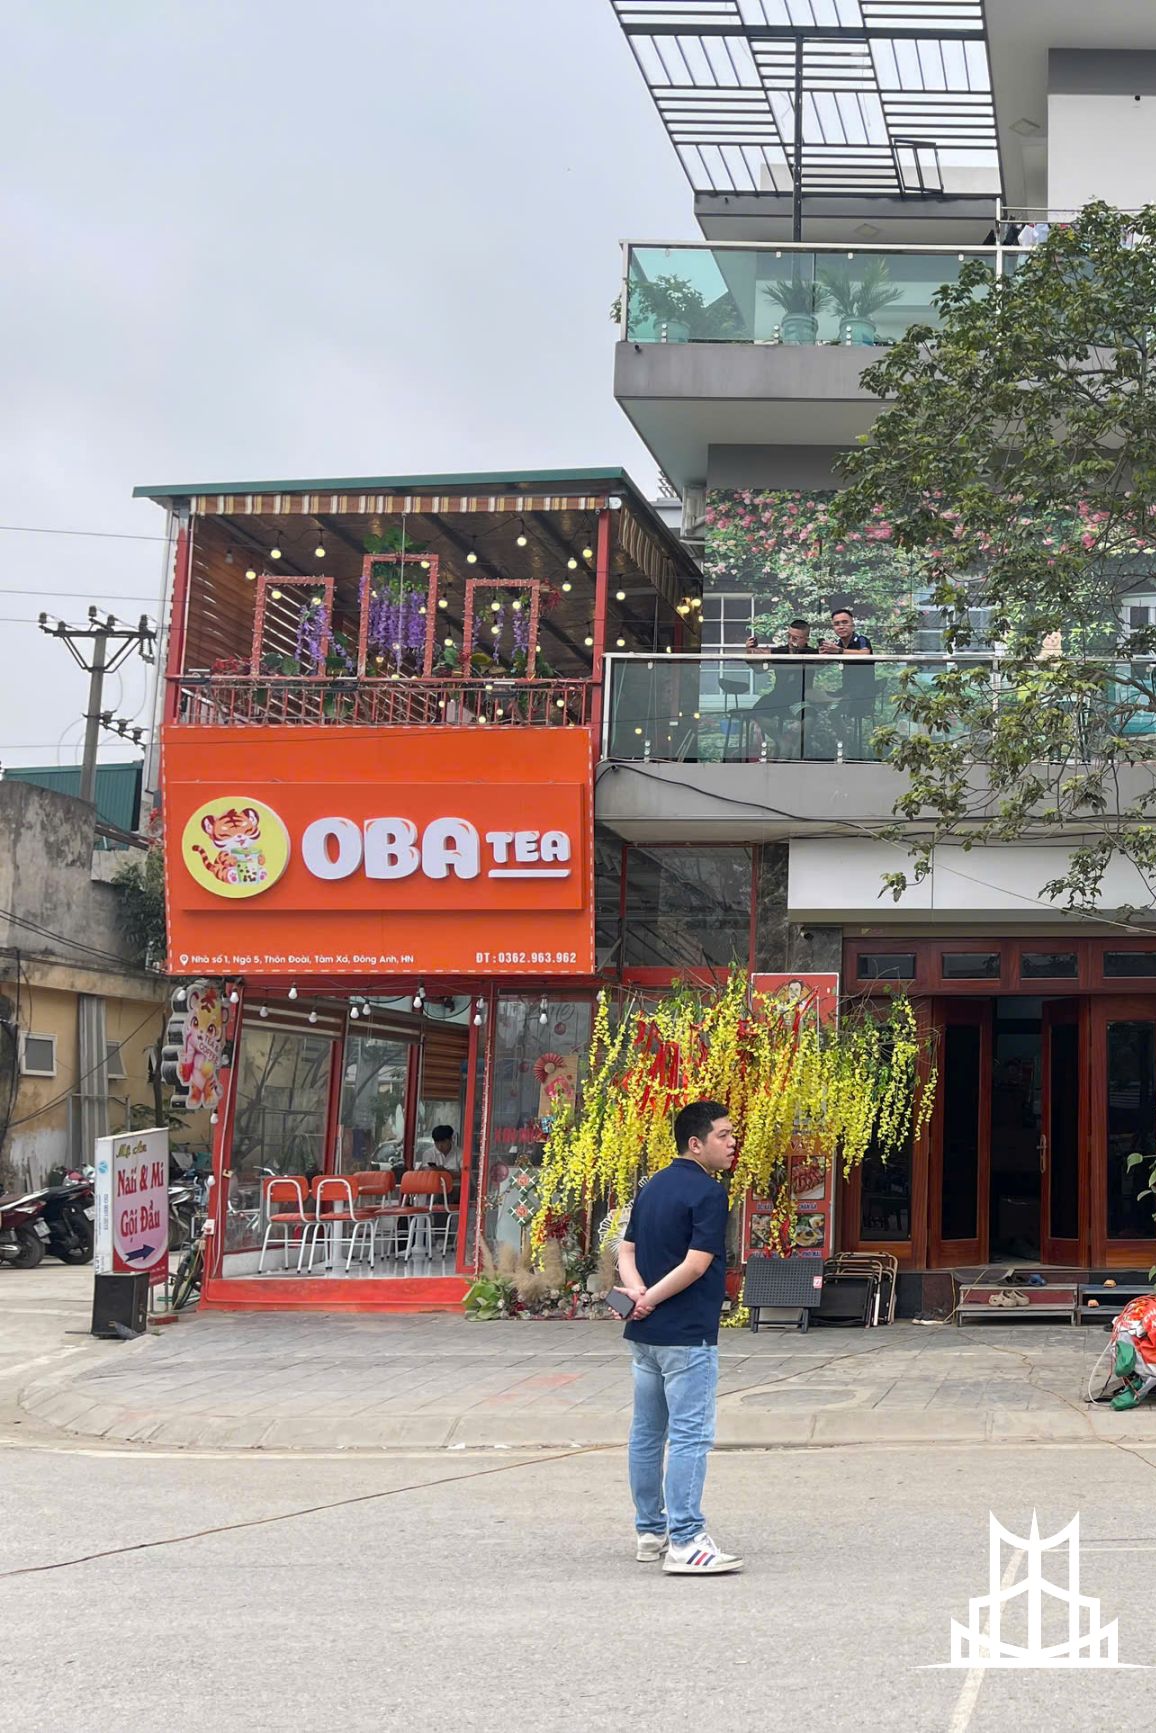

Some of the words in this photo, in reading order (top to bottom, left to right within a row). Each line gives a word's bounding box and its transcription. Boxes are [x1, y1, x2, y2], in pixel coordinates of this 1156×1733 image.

[302, 816, 480, 880] OBA
[486, 831, 571, 863] TEA
[191, 954, 209, 964] Nhà
[401, 955, 414, 964] HN
[139, 1165, 149, 1191] &
[150, 1162, 164, 1189] Mi
[120, 1208, 138, 1243] Gội
